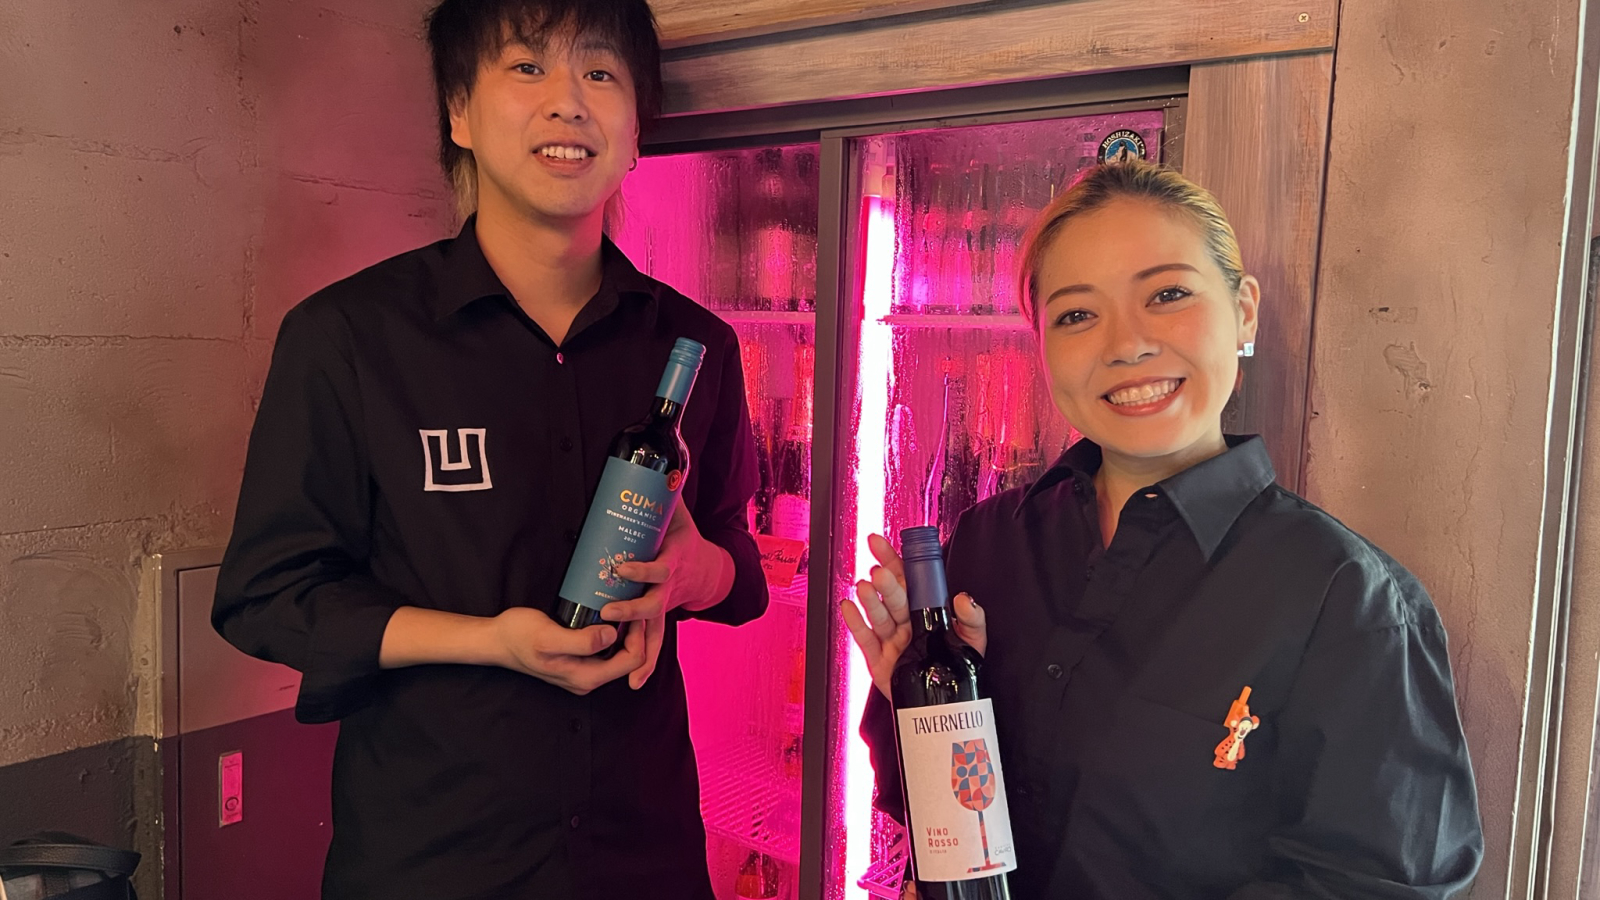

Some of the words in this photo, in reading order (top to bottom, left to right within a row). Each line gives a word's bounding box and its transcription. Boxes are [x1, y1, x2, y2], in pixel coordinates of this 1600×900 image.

[1102, 131, 1142, 148] HOSHIZAKI
[620, 489, 663, 516] CUMA
[621, 504, 657, 521] ORGANIC
[618, 525, 646, 540] MALBEC
[912, 710, 984, 735] TAVERNELLO
[926, 826, 948, 837] VINO
[928, 838, 959, 848] ROSSO
